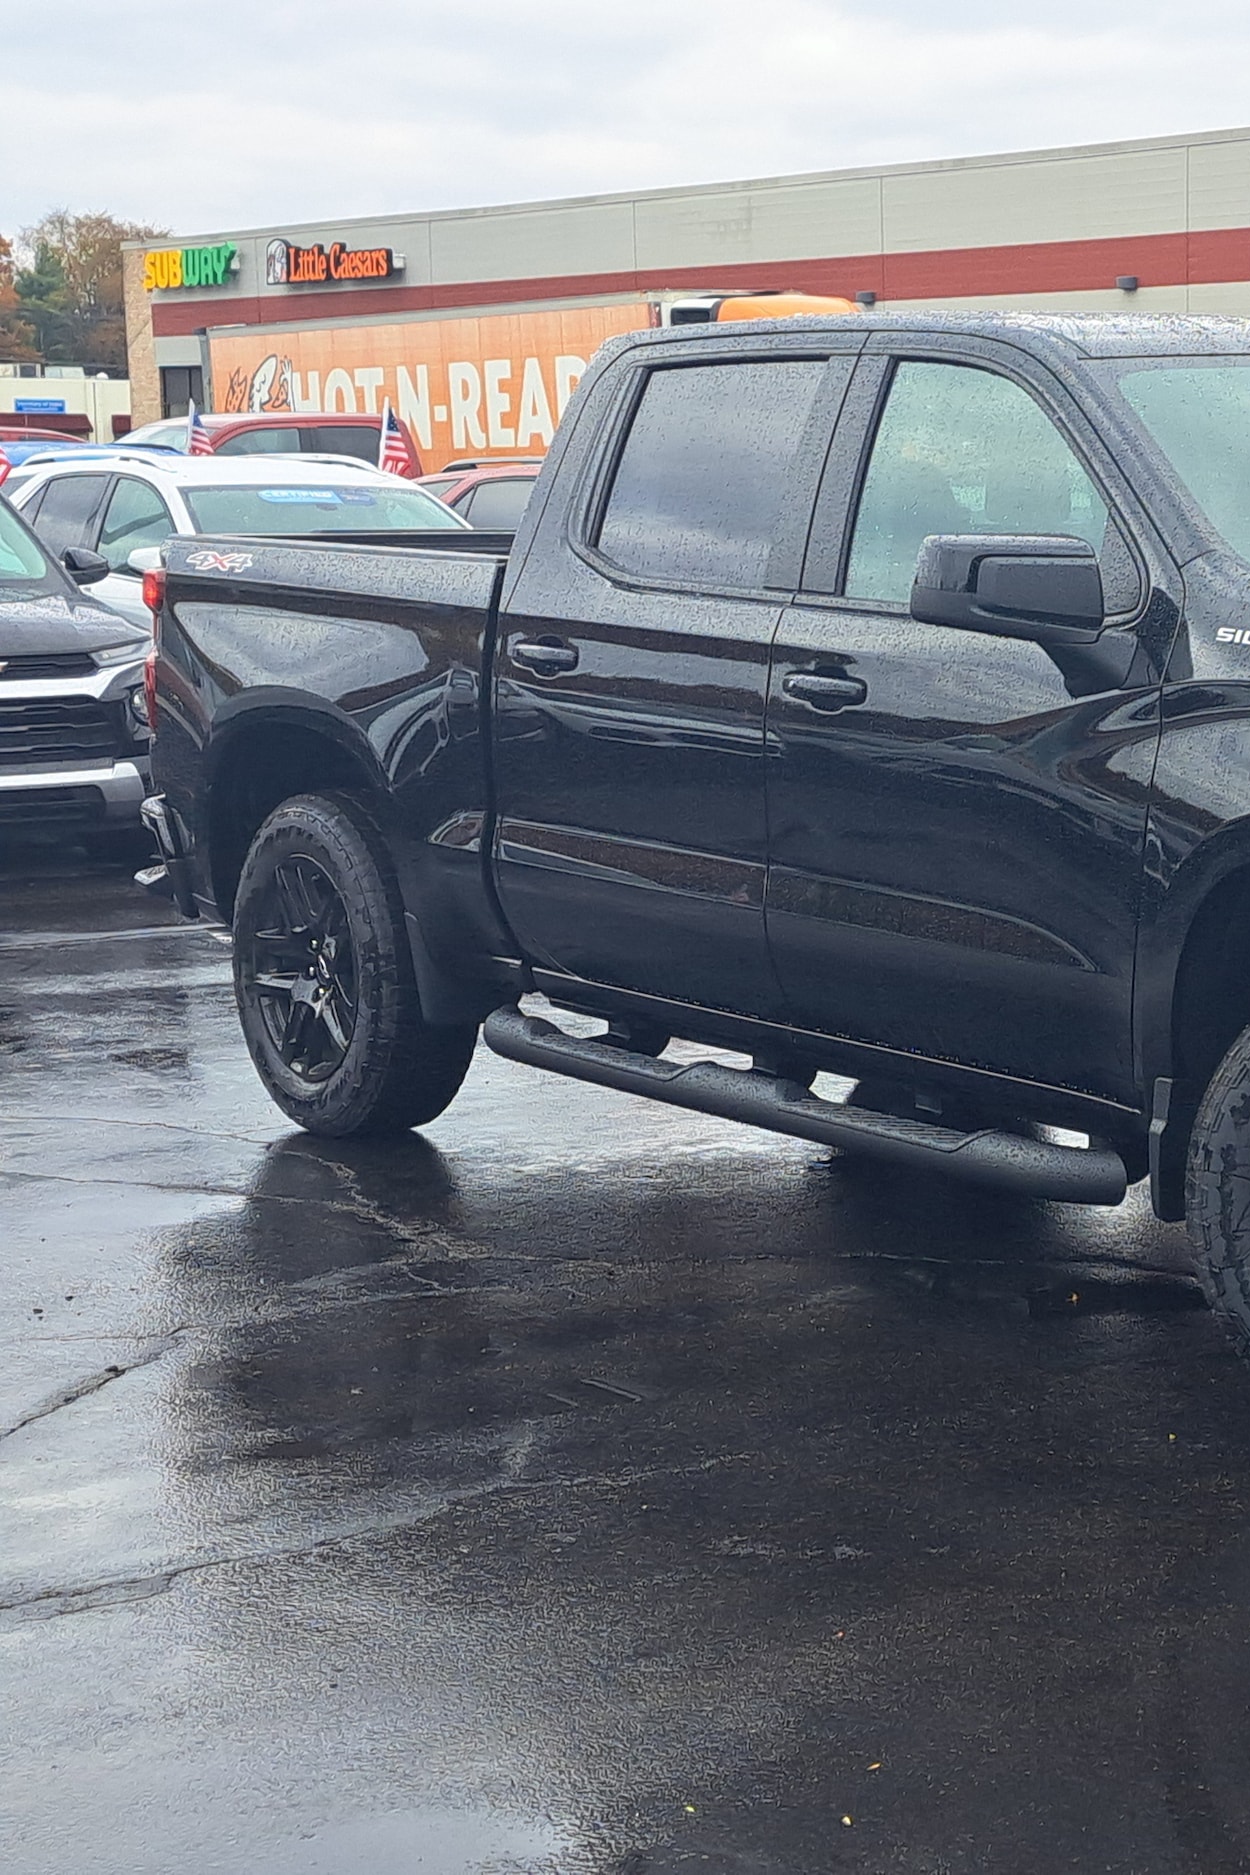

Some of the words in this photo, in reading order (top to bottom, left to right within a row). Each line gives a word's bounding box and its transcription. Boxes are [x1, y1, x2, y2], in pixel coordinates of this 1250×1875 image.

[144, 241, 236, 290] SUBWAY
[288, 246, 327, 282] Little
[330, 243, 388, 279] Caesars
